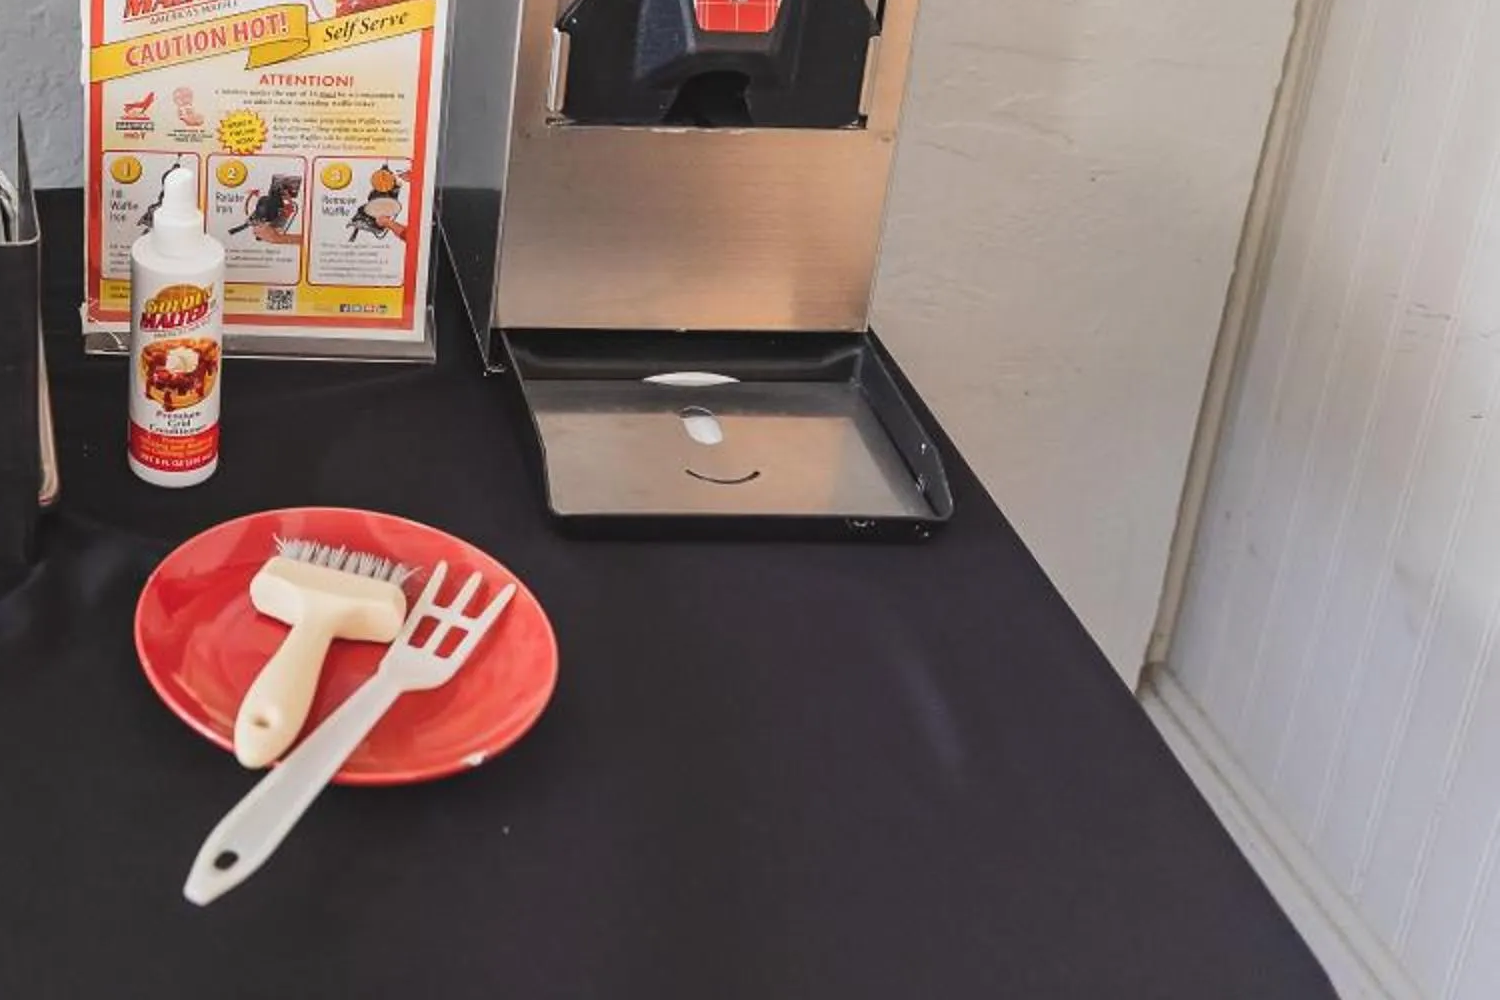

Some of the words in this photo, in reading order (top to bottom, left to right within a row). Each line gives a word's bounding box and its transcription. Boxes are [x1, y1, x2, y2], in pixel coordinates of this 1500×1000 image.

[125, 25, 227, 67] CAUTION
[233, 12, 289, 44] HOT!
[322, 19, 356, 44] Self
[356, 12, 409, 33] Serve
[260, 75, 355, 87] ATTENTION!
